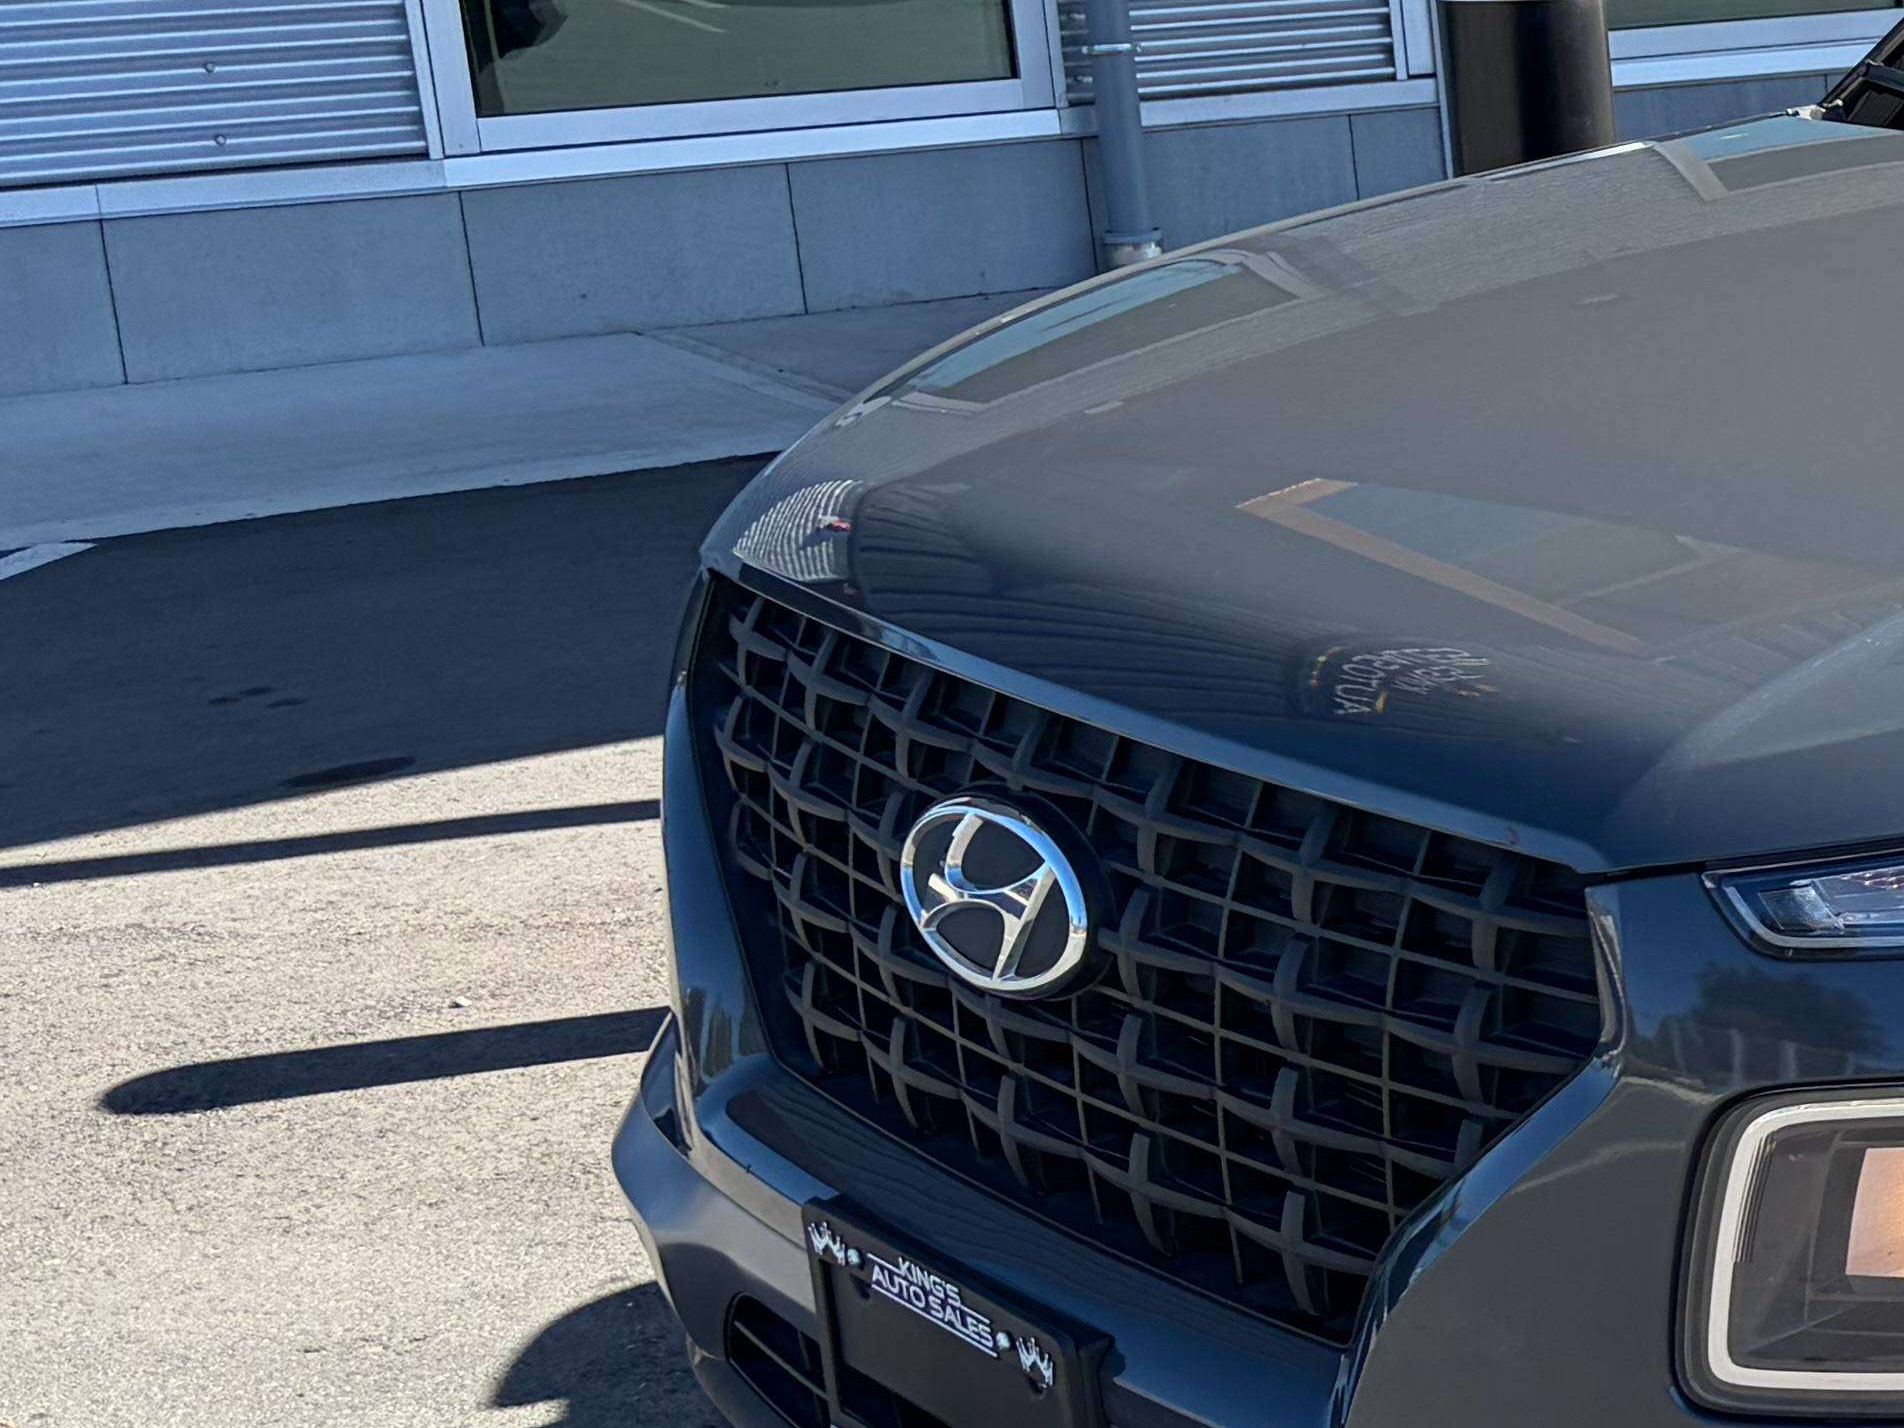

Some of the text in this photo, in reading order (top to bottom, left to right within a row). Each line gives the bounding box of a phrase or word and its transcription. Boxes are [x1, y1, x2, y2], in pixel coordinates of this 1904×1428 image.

[872, 1265, 994, 1348] AUTO SALES
[899, 1257, 961, 1307] KING'S
